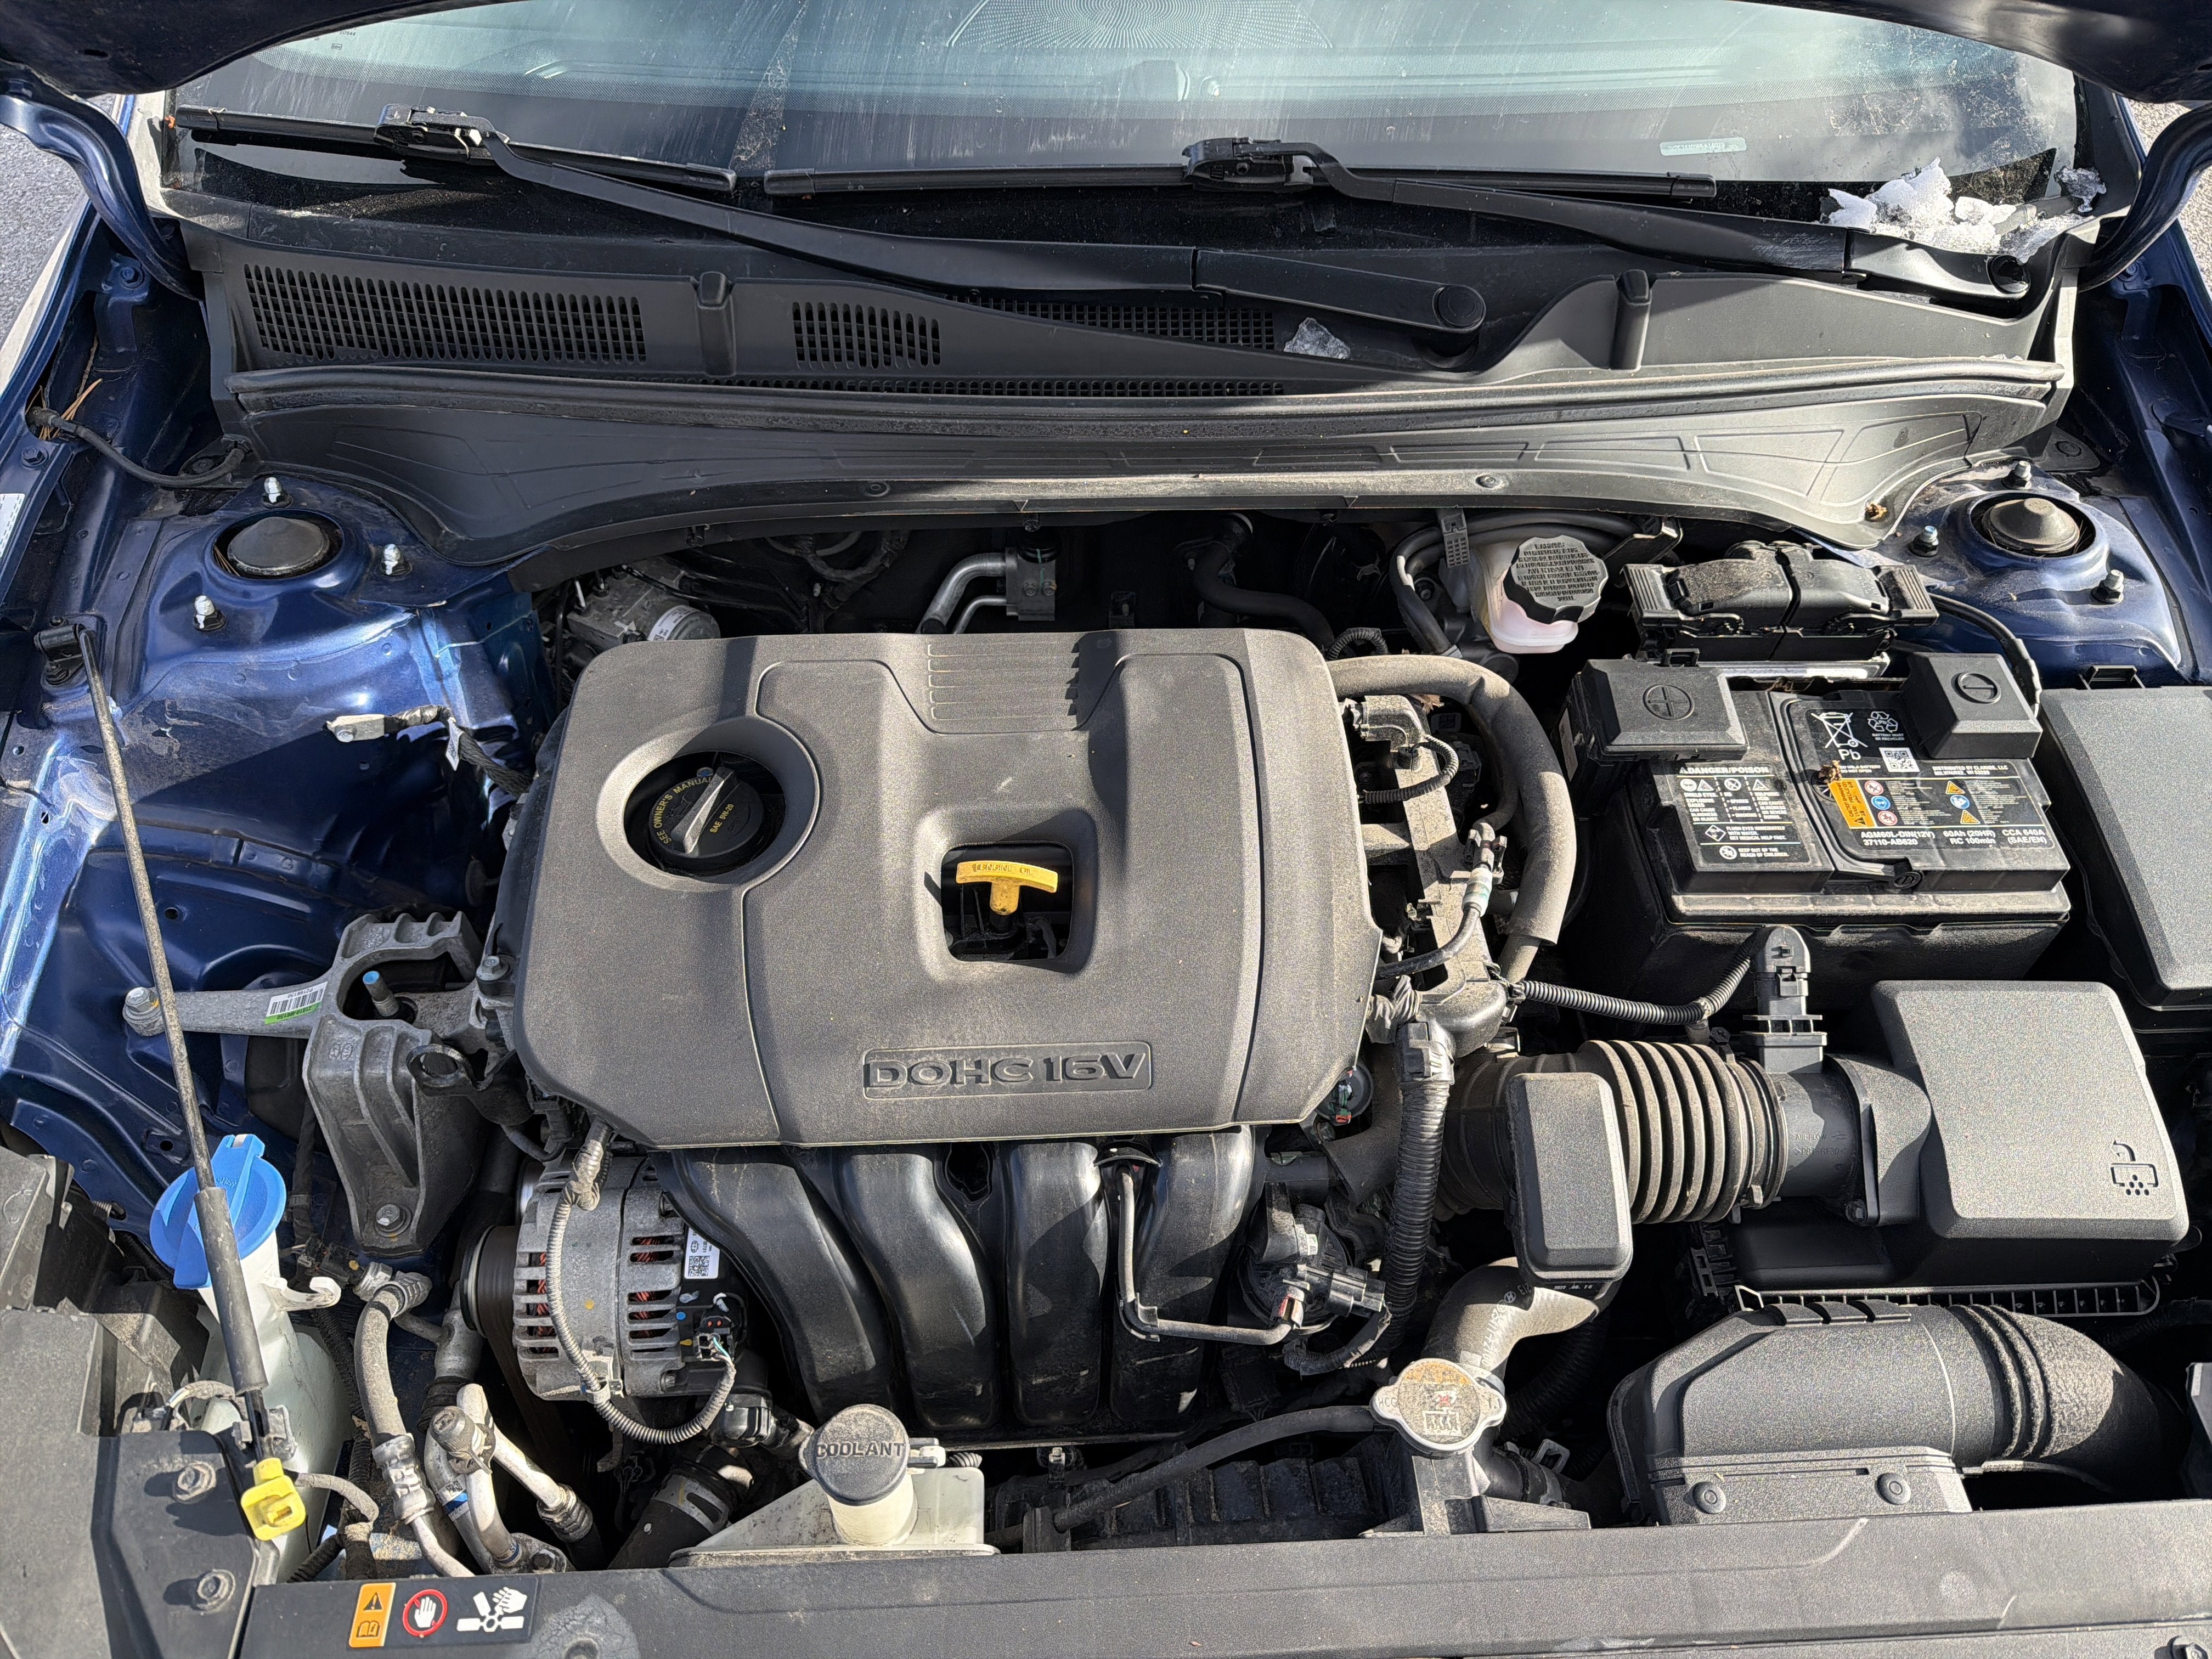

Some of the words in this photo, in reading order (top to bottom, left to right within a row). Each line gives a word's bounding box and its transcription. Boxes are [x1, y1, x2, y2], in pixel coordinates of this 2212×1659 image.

[1838, 749, 1861, 760] Pb
[654, 794, 673, 828] OWNER'S
[709, 821, 723, 833] SAE
[719, 804, 735, 820] 5W-20
[657, 828, 672, 845] SEE
[1967, 830, 1996, 838] (20HR)
[2007, 836, 2047, 844] (SAE/EN)
[1019, 867, 1033, 876] OIL
[864, 1058, 1034, 1088] DOHC
[1043, 1052, 1146, 1083] 16V
[216, 1176, 237, 1189] SHER
[816, 1442, 906, 1458] COOLANT
